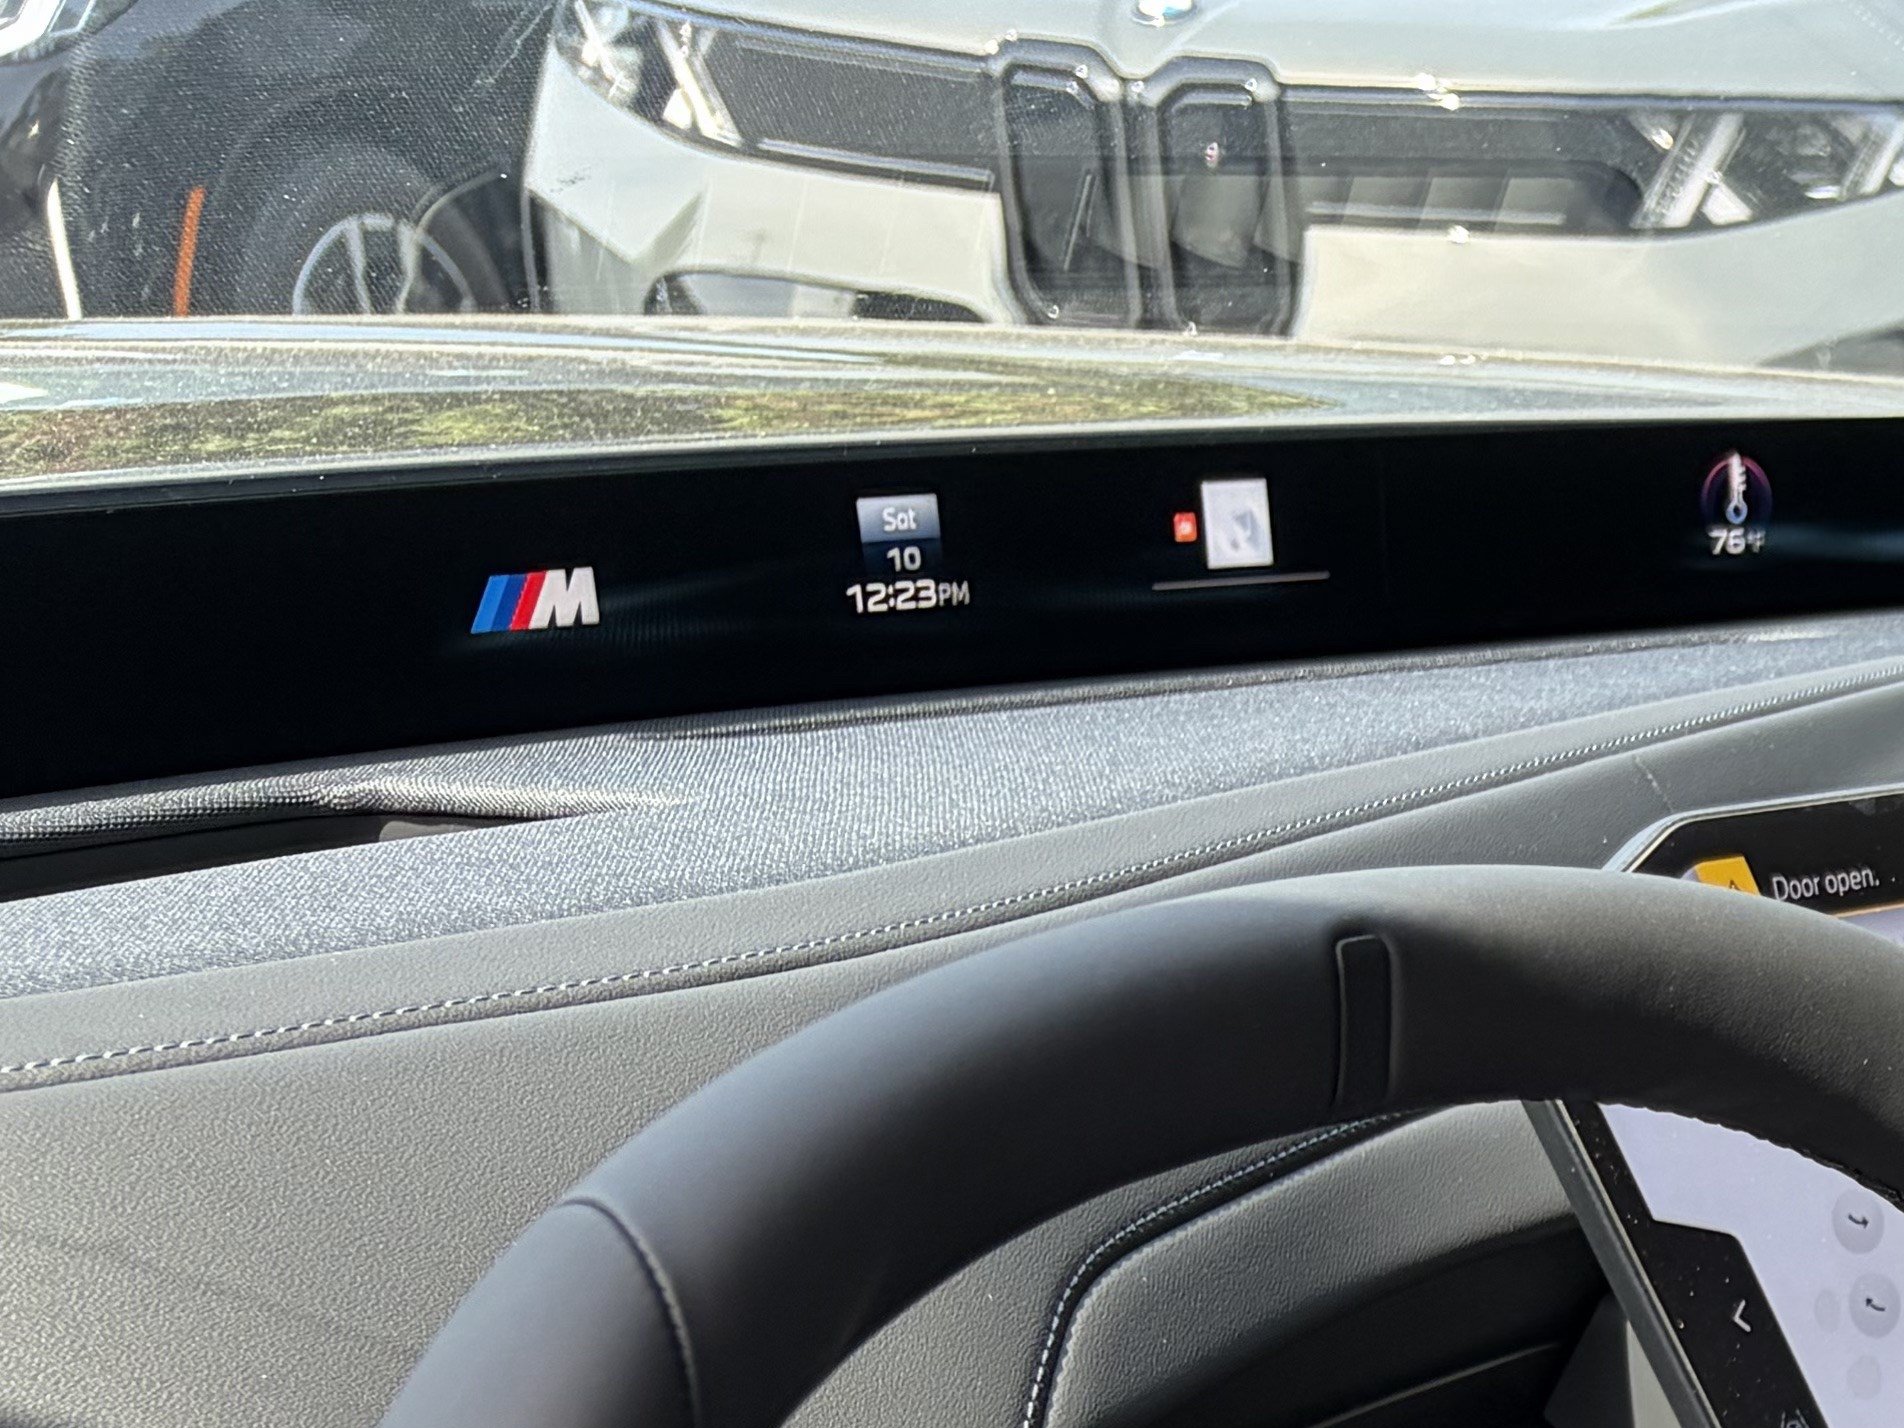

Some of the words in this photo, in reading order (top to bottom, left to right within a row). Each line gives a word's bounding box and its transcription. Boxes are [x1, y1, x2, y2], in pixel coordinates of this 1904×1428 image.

[881, 508, 917, 532] Sat
[887, 546, 922, 572] 10
[1772, 873, 1820, 901] Door
[1824, 869, 1880, 897] open.
